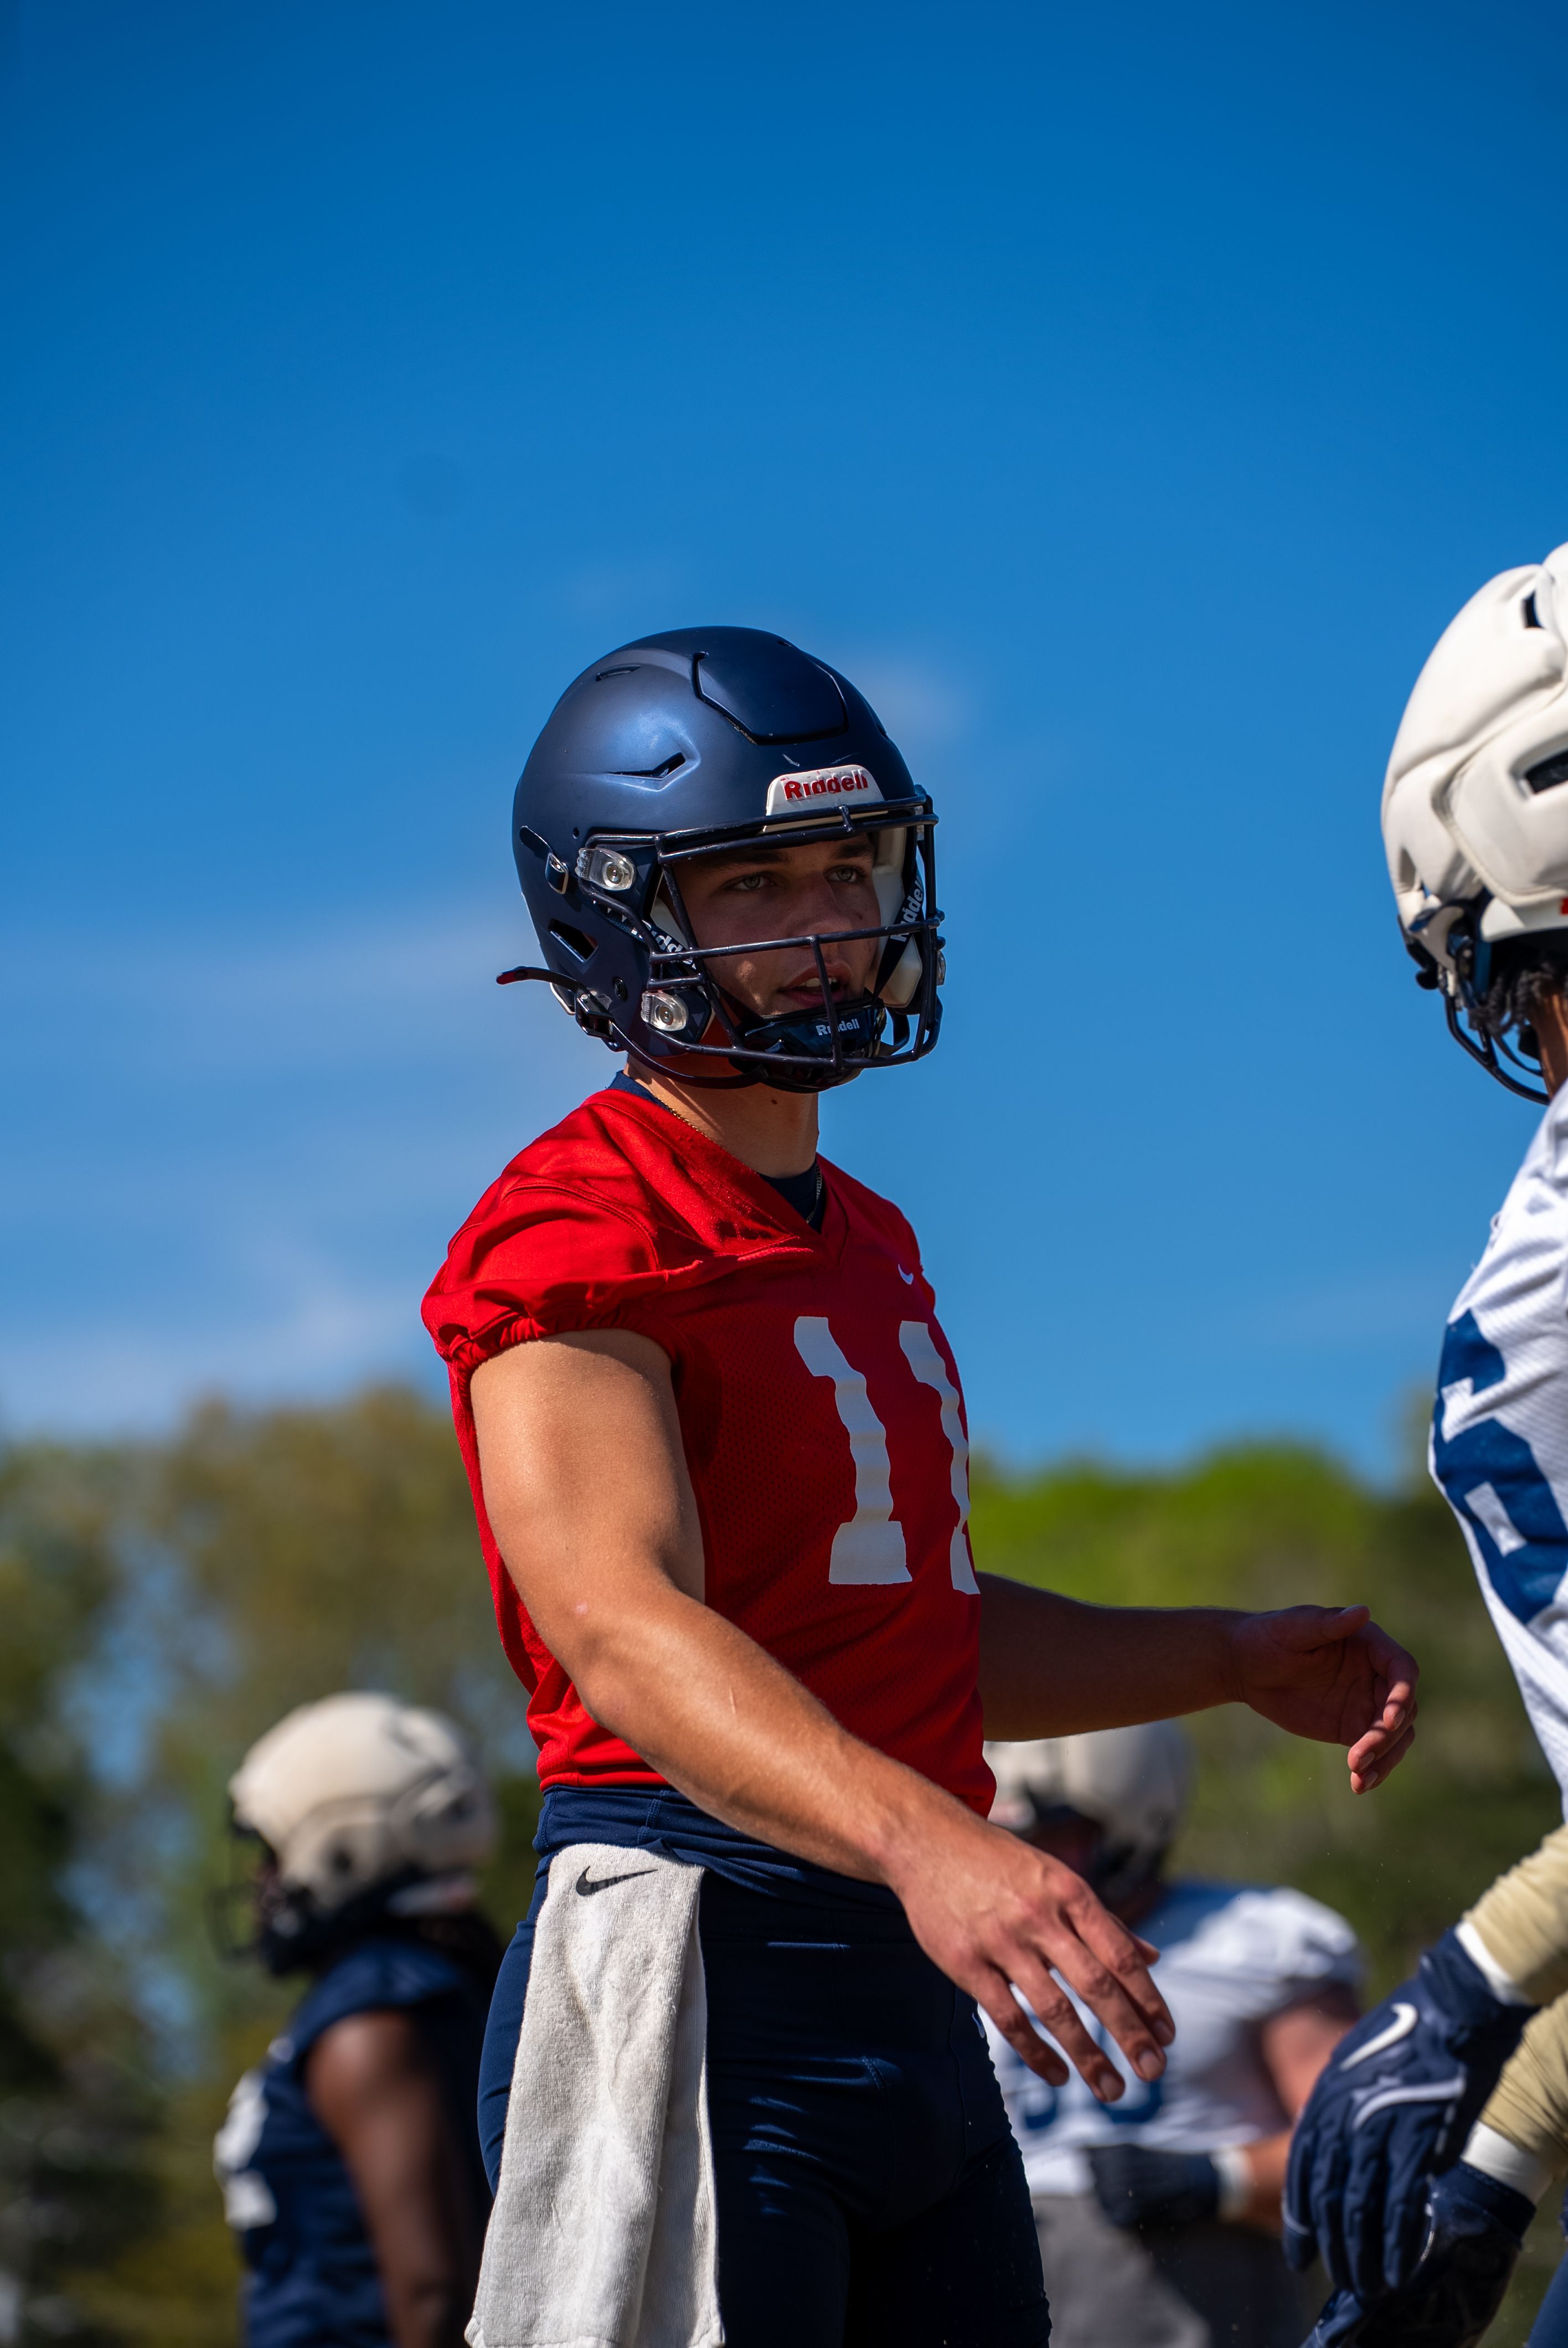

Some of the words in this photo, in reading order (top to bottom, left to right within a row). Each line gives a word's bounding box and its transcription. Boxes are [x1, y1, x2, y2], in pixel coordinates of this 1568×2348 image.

[783, 770, 869, 800] Riddell
[816, 1018, 860, 1036] Ridell
[794, 1316, 981, 1595] 11
